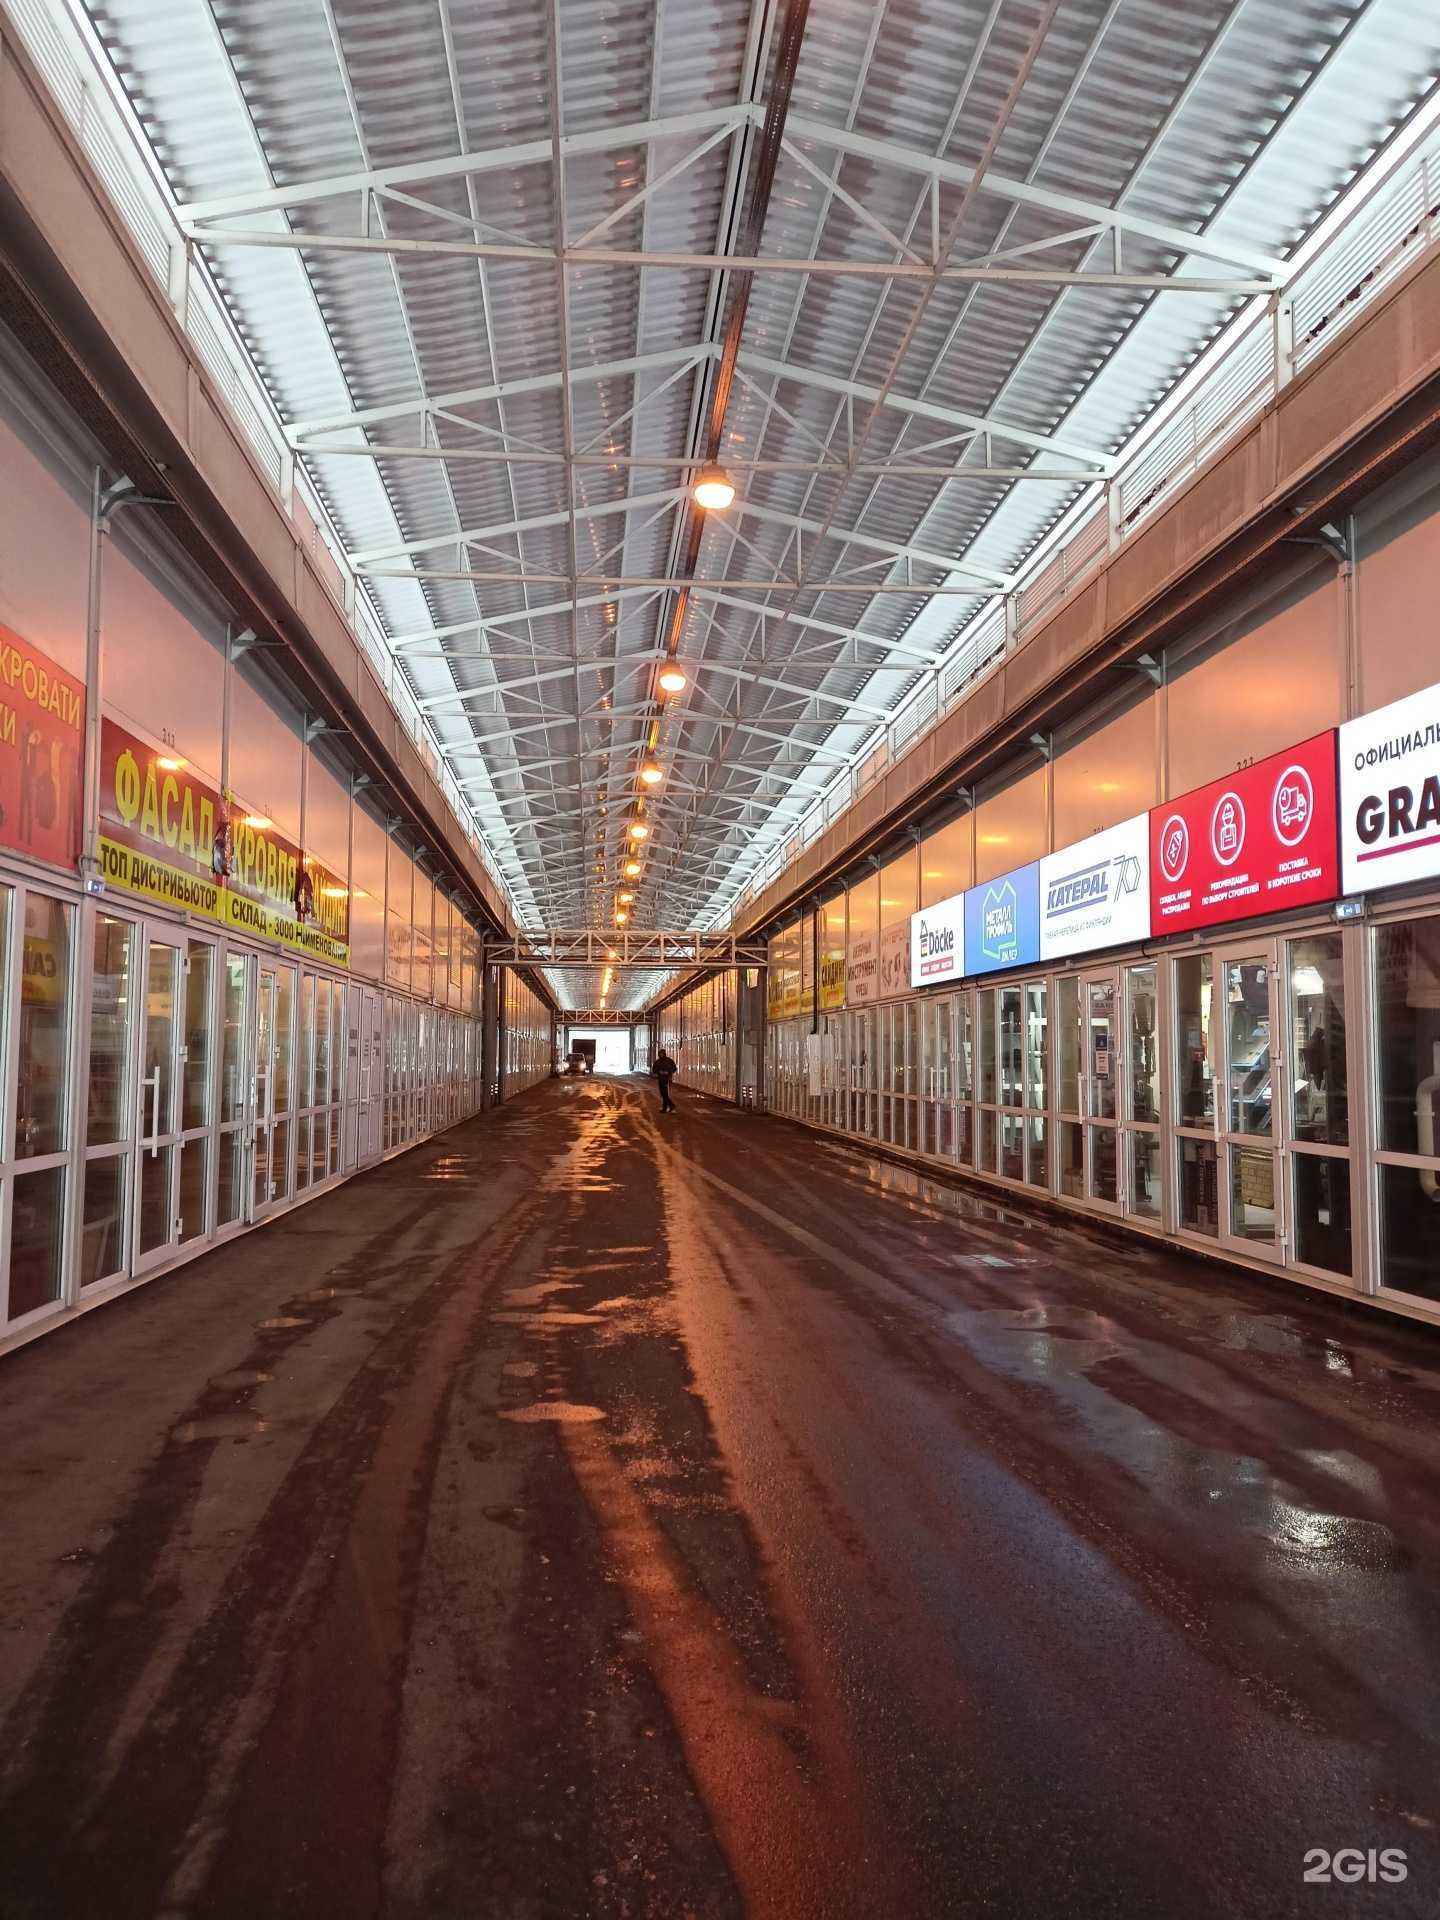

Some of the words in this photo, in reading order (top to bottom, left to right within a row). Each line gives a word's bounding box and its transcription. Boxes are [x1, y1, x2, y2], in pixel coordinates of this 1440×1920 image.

[115, 749, 214, 873] ФАСАД
[1356, 775, 1440, 844] GRA
[101, 844, 127, 880] ТОП
[131, 857, 217, 911] ДИСТРИБЬЮТОР
[232, 820, 296, 905] КРОВЛЯ
[1047, 871, 1109, 910] KATEPAL
[231, 898, 267, 934] СКЛАД
[274, 917, 294, 940] 3000
